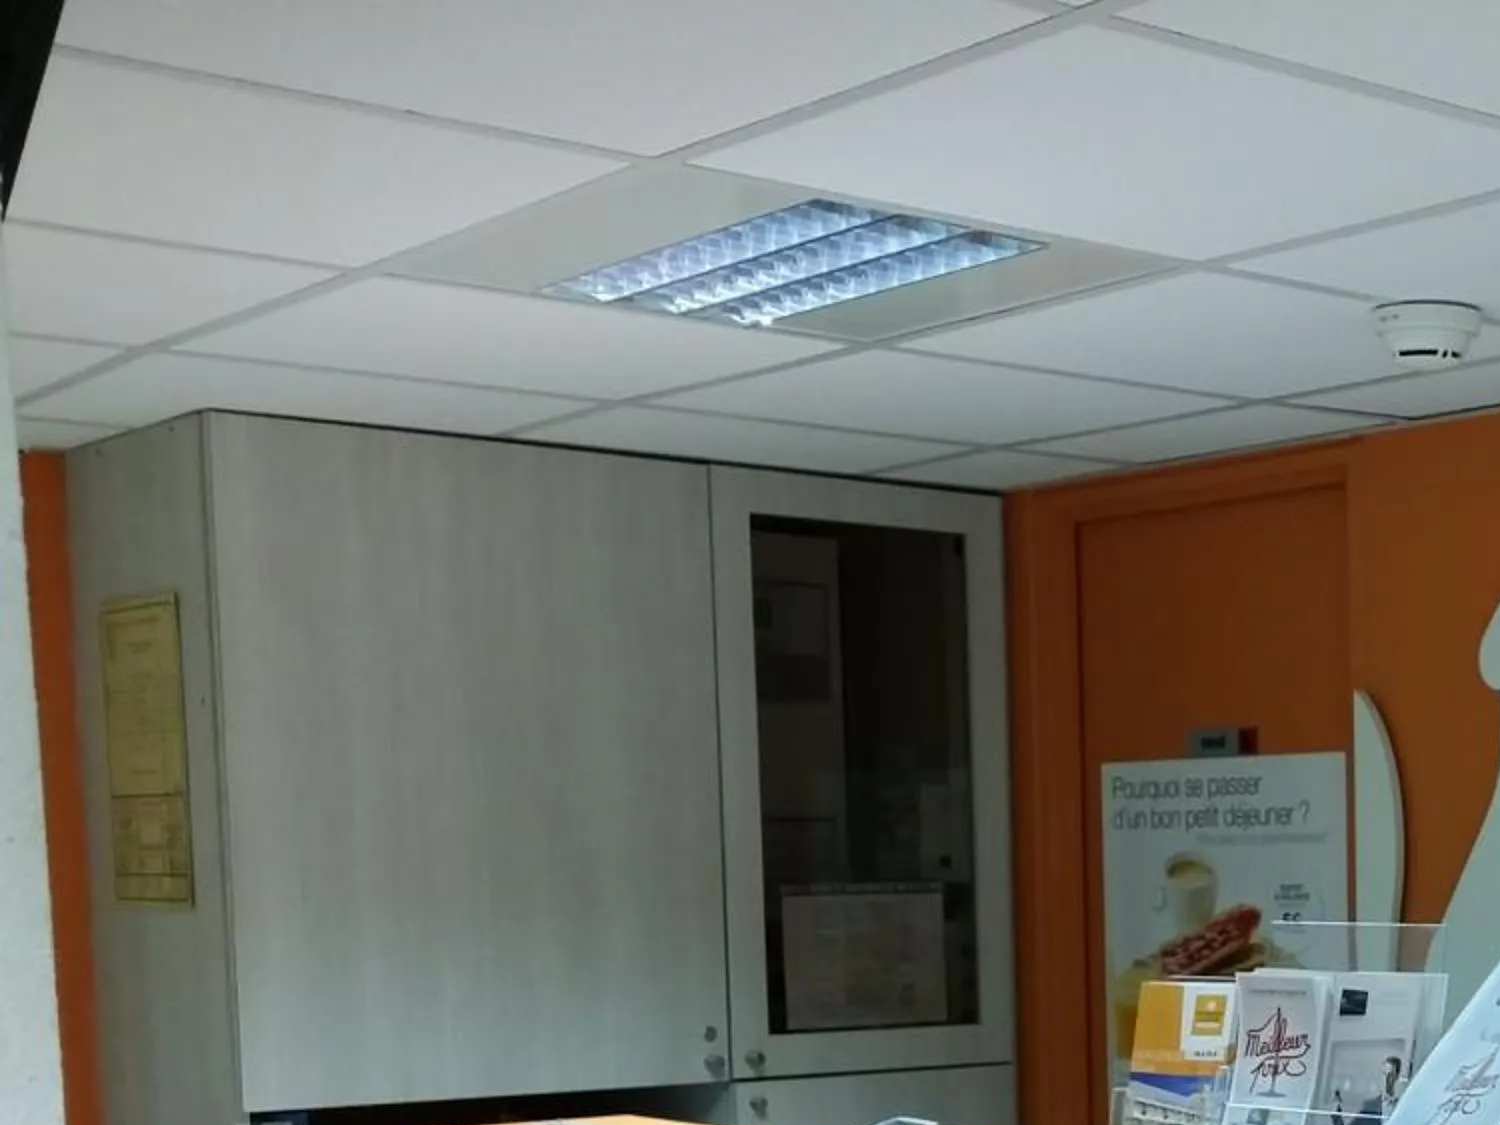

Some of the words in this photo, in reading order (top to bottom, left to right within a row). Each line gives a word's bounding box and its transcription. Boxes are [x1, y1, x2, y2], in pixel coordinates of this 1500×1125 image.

[1112, 776, 1180, 801] Pourquoi
[1184, 777, 1203, 798] se
[1207, 776, 1262, 801] passer
[1150, 808, 1181, 830] bon
[1185, 803, 1219, 833] petit
